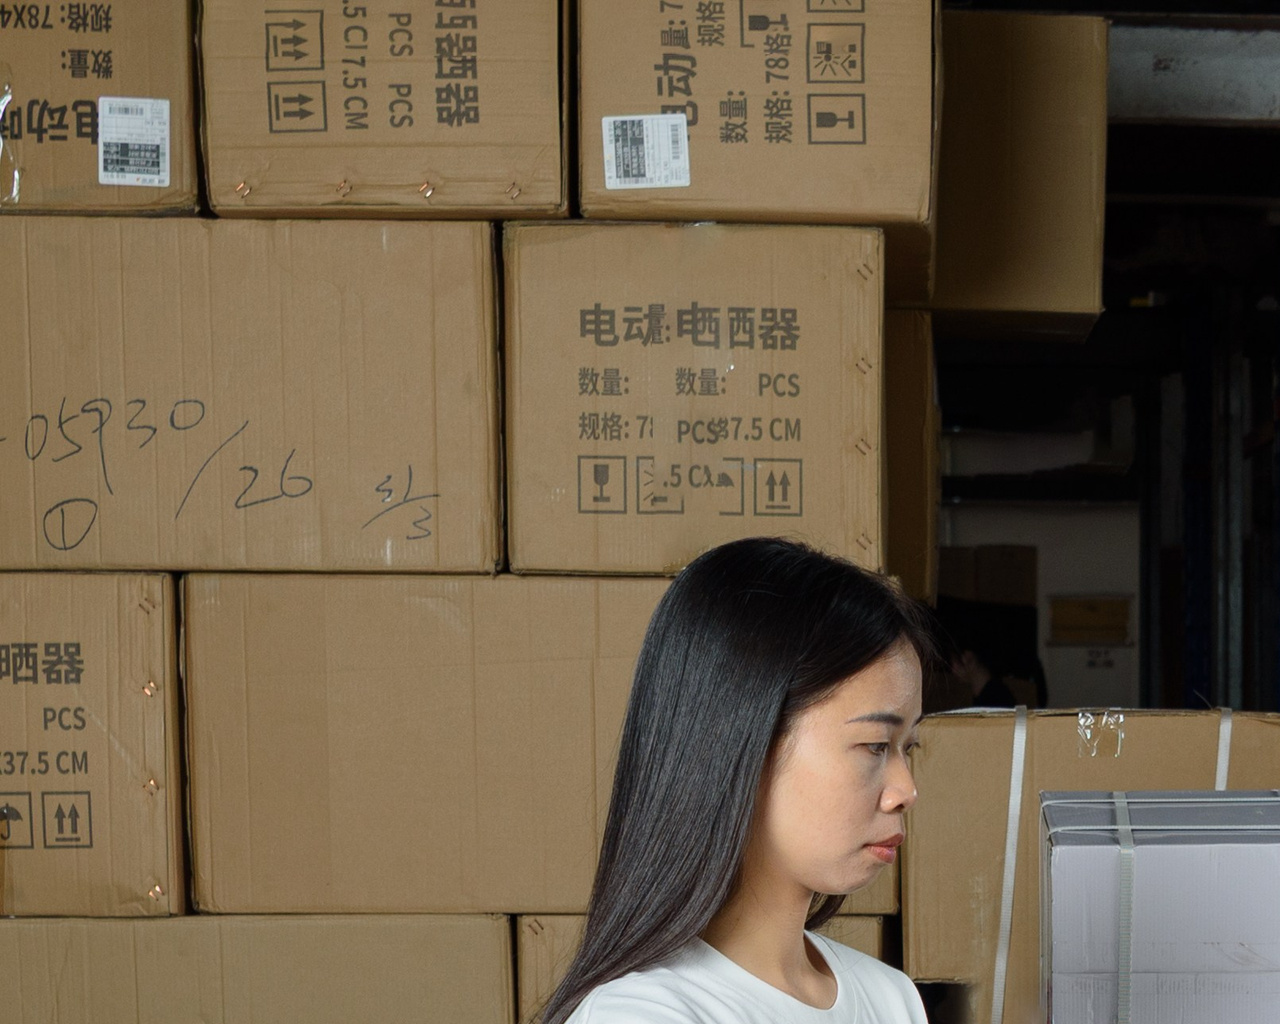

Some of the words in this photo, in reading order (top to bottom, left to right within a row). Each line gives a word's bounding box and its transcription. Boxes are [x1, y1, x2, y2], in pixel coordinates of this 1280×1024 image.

[388, 13, 413, 57] PCS
[61, 49, 112, 79] 数量:
[388, 84, 413, 128] PCS
[720, 90, 749, 144] 数量:
[578, 367, 629, 397] 数量:
[675, 367, 726, 397] 数量:
[758, 373, 800, 398] PCS
[769, 418, 801, 442] CM
[43, 707, 87, 731] PCS
[56, 751, 88, 775] CM
